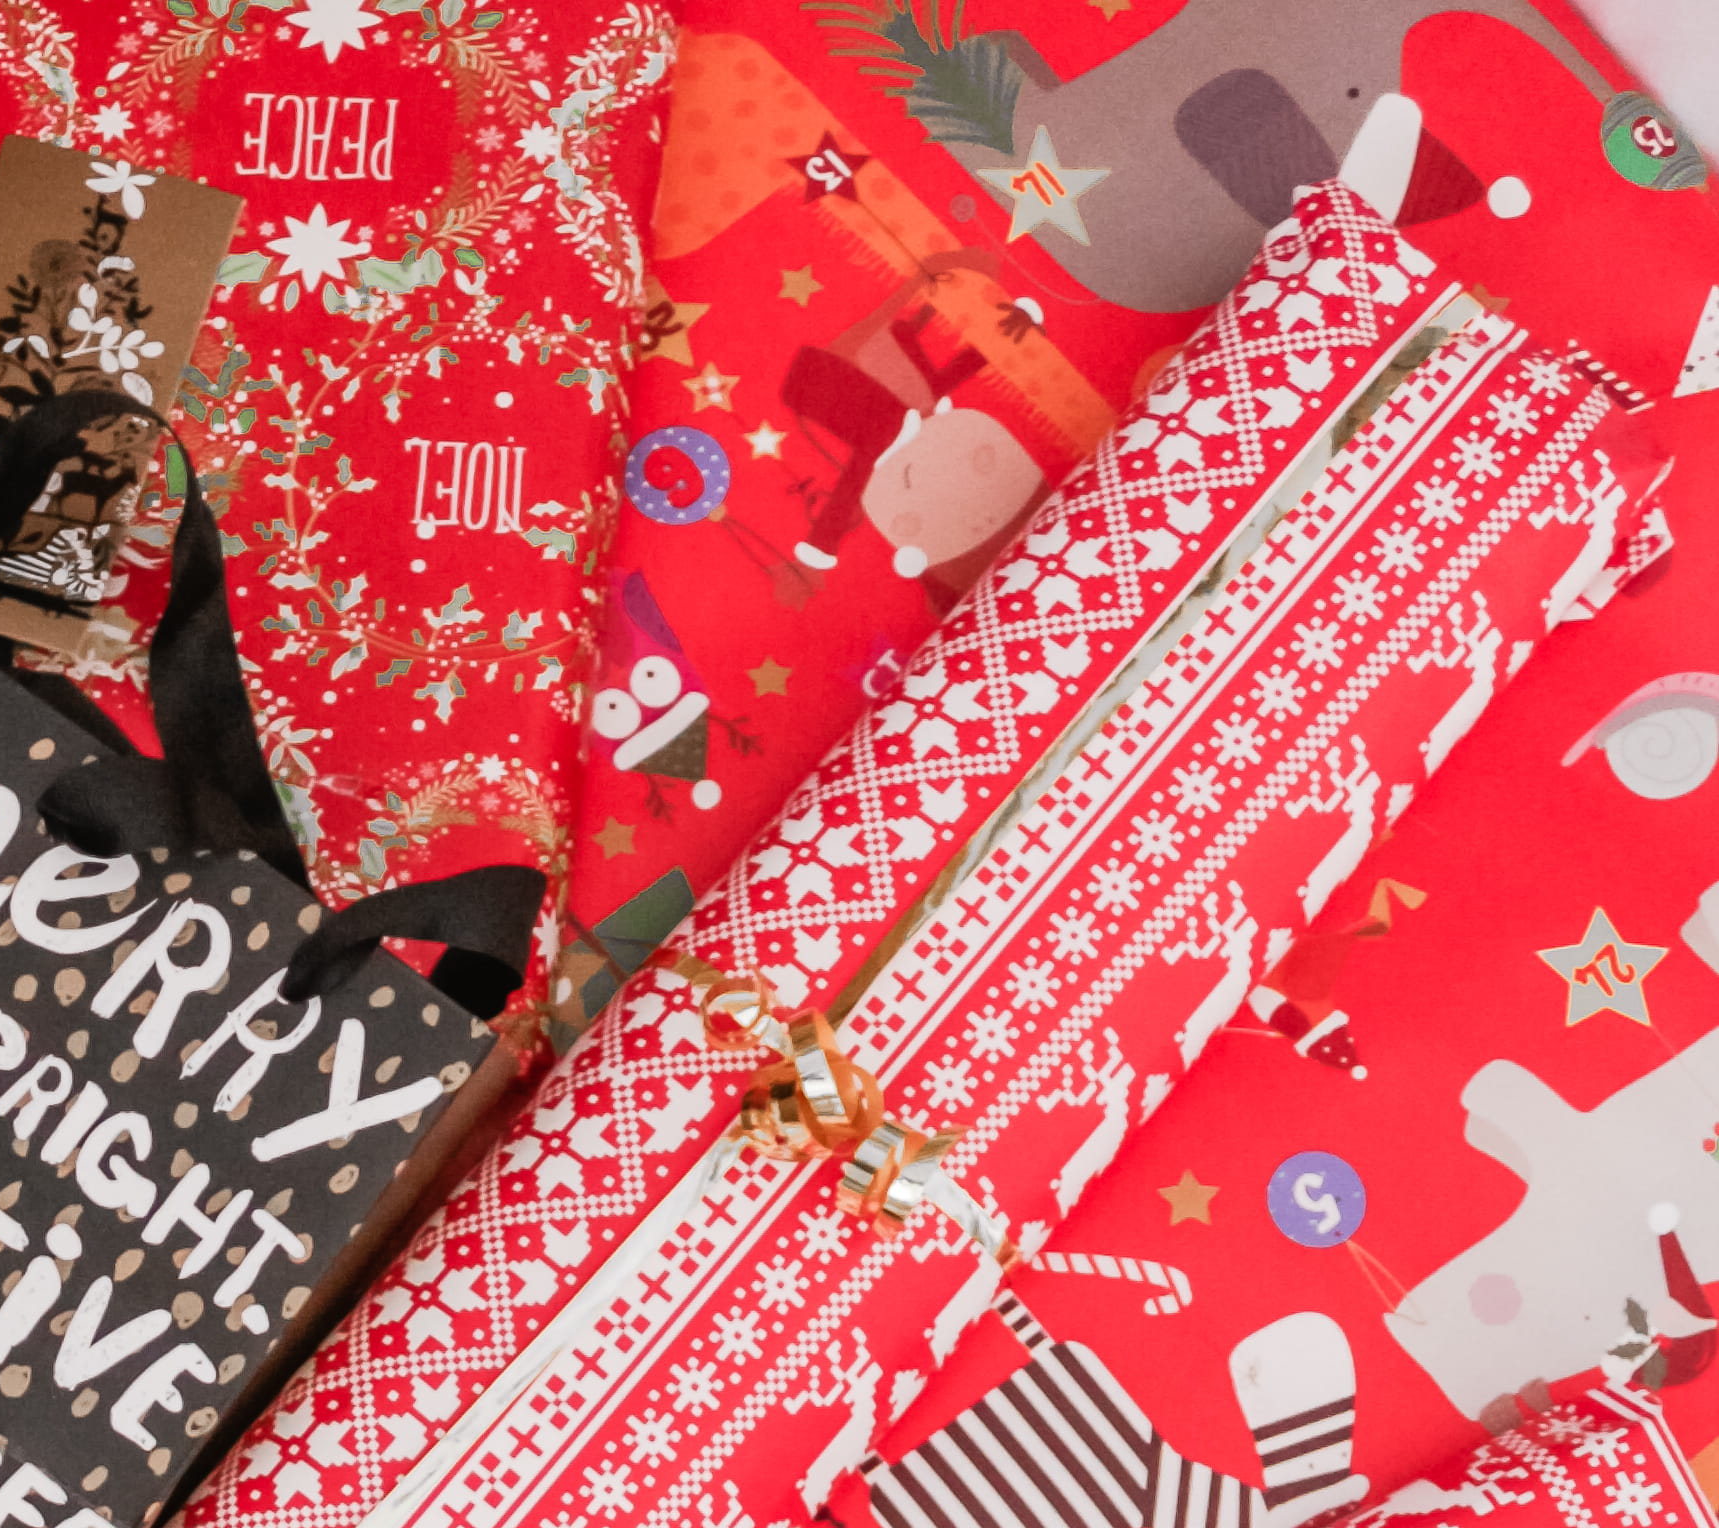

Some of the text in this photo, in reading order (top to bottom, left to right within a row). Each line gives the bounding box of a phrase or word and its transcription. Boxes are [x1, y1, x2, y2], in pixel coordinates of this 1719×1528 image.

[234, 92, 400, 181] PEACE
[805, 148, 853, 192] 13
[403, 436, 527, 534] NOEL
[1292, 1172, 1342, 1235] 5
